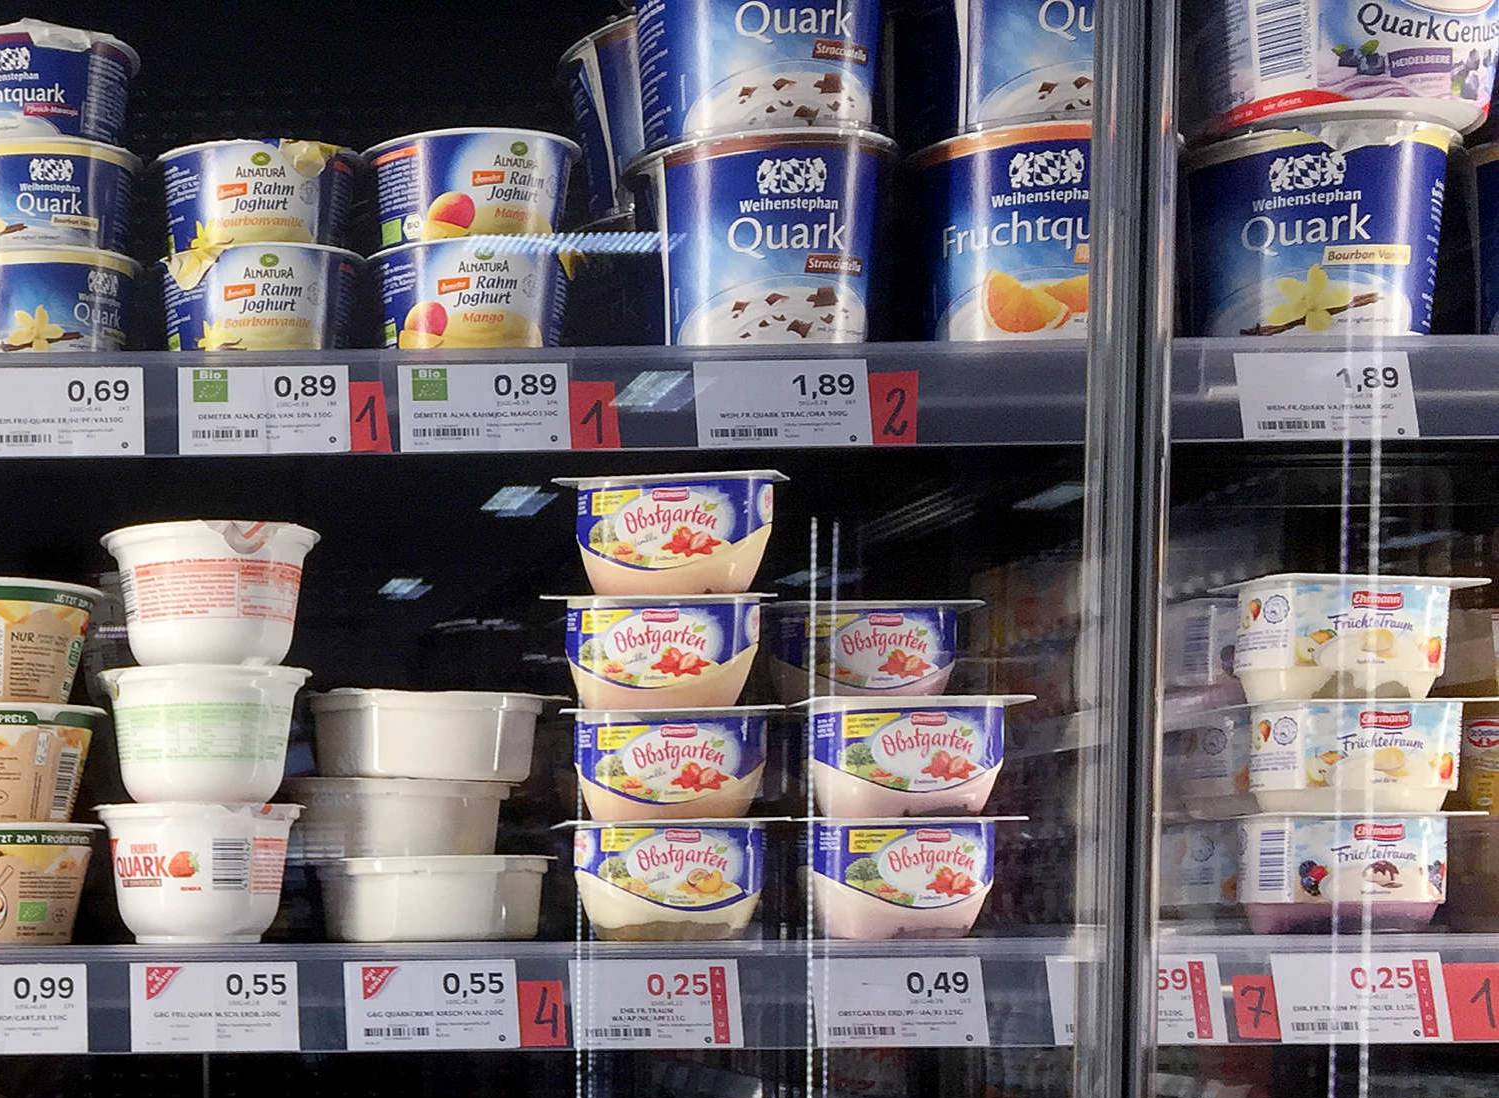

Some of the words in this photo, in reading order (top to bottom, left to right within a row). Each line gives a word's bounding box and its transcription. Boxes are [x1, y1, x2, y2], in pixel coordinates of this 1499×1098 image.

[733, 0, 853, 43] Quark
[252, 181, 296, 197] Rahm
[488, 184, 539, 202] Joghurt
[509, 171, 544, 189] Rahm
[16, 192, 83, 217] Quark
[231, 197, 288, 213] Joghurt
[740, 197, 839, 214] Weihenstephan
[991, 188, 1090, 208] Weihenstepha
[1252, 189, 1362, 213] Weihenstephan
[727, 213, 847, 259] Quark
[1241, 203, 1372, 256] Quark
[1327, 249, 1376, 262] Bourbon
[261, 282, 303, 298] Rahm
[476, 274, 518, 291] Rahm
[240, 298, 296, 314] Joghurt
[454, 291, 512, 307] Joghurt
[73, 302, 122, 330] Quark
[462, 311, 505, 325] Mango
[198, 370, 221, 380] Bio
[419, 369, 441, 378] Bio
[493, 373, 557, 400] 0,89
[792, 372, 855, 400] 1,89
[1336, 366, 1400, 393] 1,89
[67, 379, 130, 406] 0,69
[273, 374, 337, 402] 0,89
[355, 396, 378, 441] 1
[580, 400, 603, 444] 1
[882, 387, 907, 435] 2
[623, 502, 719, 535] Obstgarten
[10, 631, 35, 644] NUR
[613, 621, 708, 655] Obstgarten
[840, 627, 929, 657] Obstgarten
[1361, 714, 1410, 727] Ehrmann
[631, 737, 726, 770] Obstgarten
[880, 726, 974, 758] Obstgarten
[15, 834, 38, 845] ZUM
[116, 855, 169, 878] QUARK
[635, 843, 730, 873] Obstgarten
[887, 843, 975, 874] Obstgarten
[12, 976, 75, 1003] 0,99
[225, 973, 287, 1000] 0,55
[442, 972, 505, 999] 0,55
[646, 972, 709, 999] 0,25
[906, 970, 970, 997] 0,49
[1350, 967, 1414, 993] 0,25
[537, 988, 559, 1039] 4
[1240, 985, 1271, 1029] 7
[1469, 977, 1497, 1029] 1
